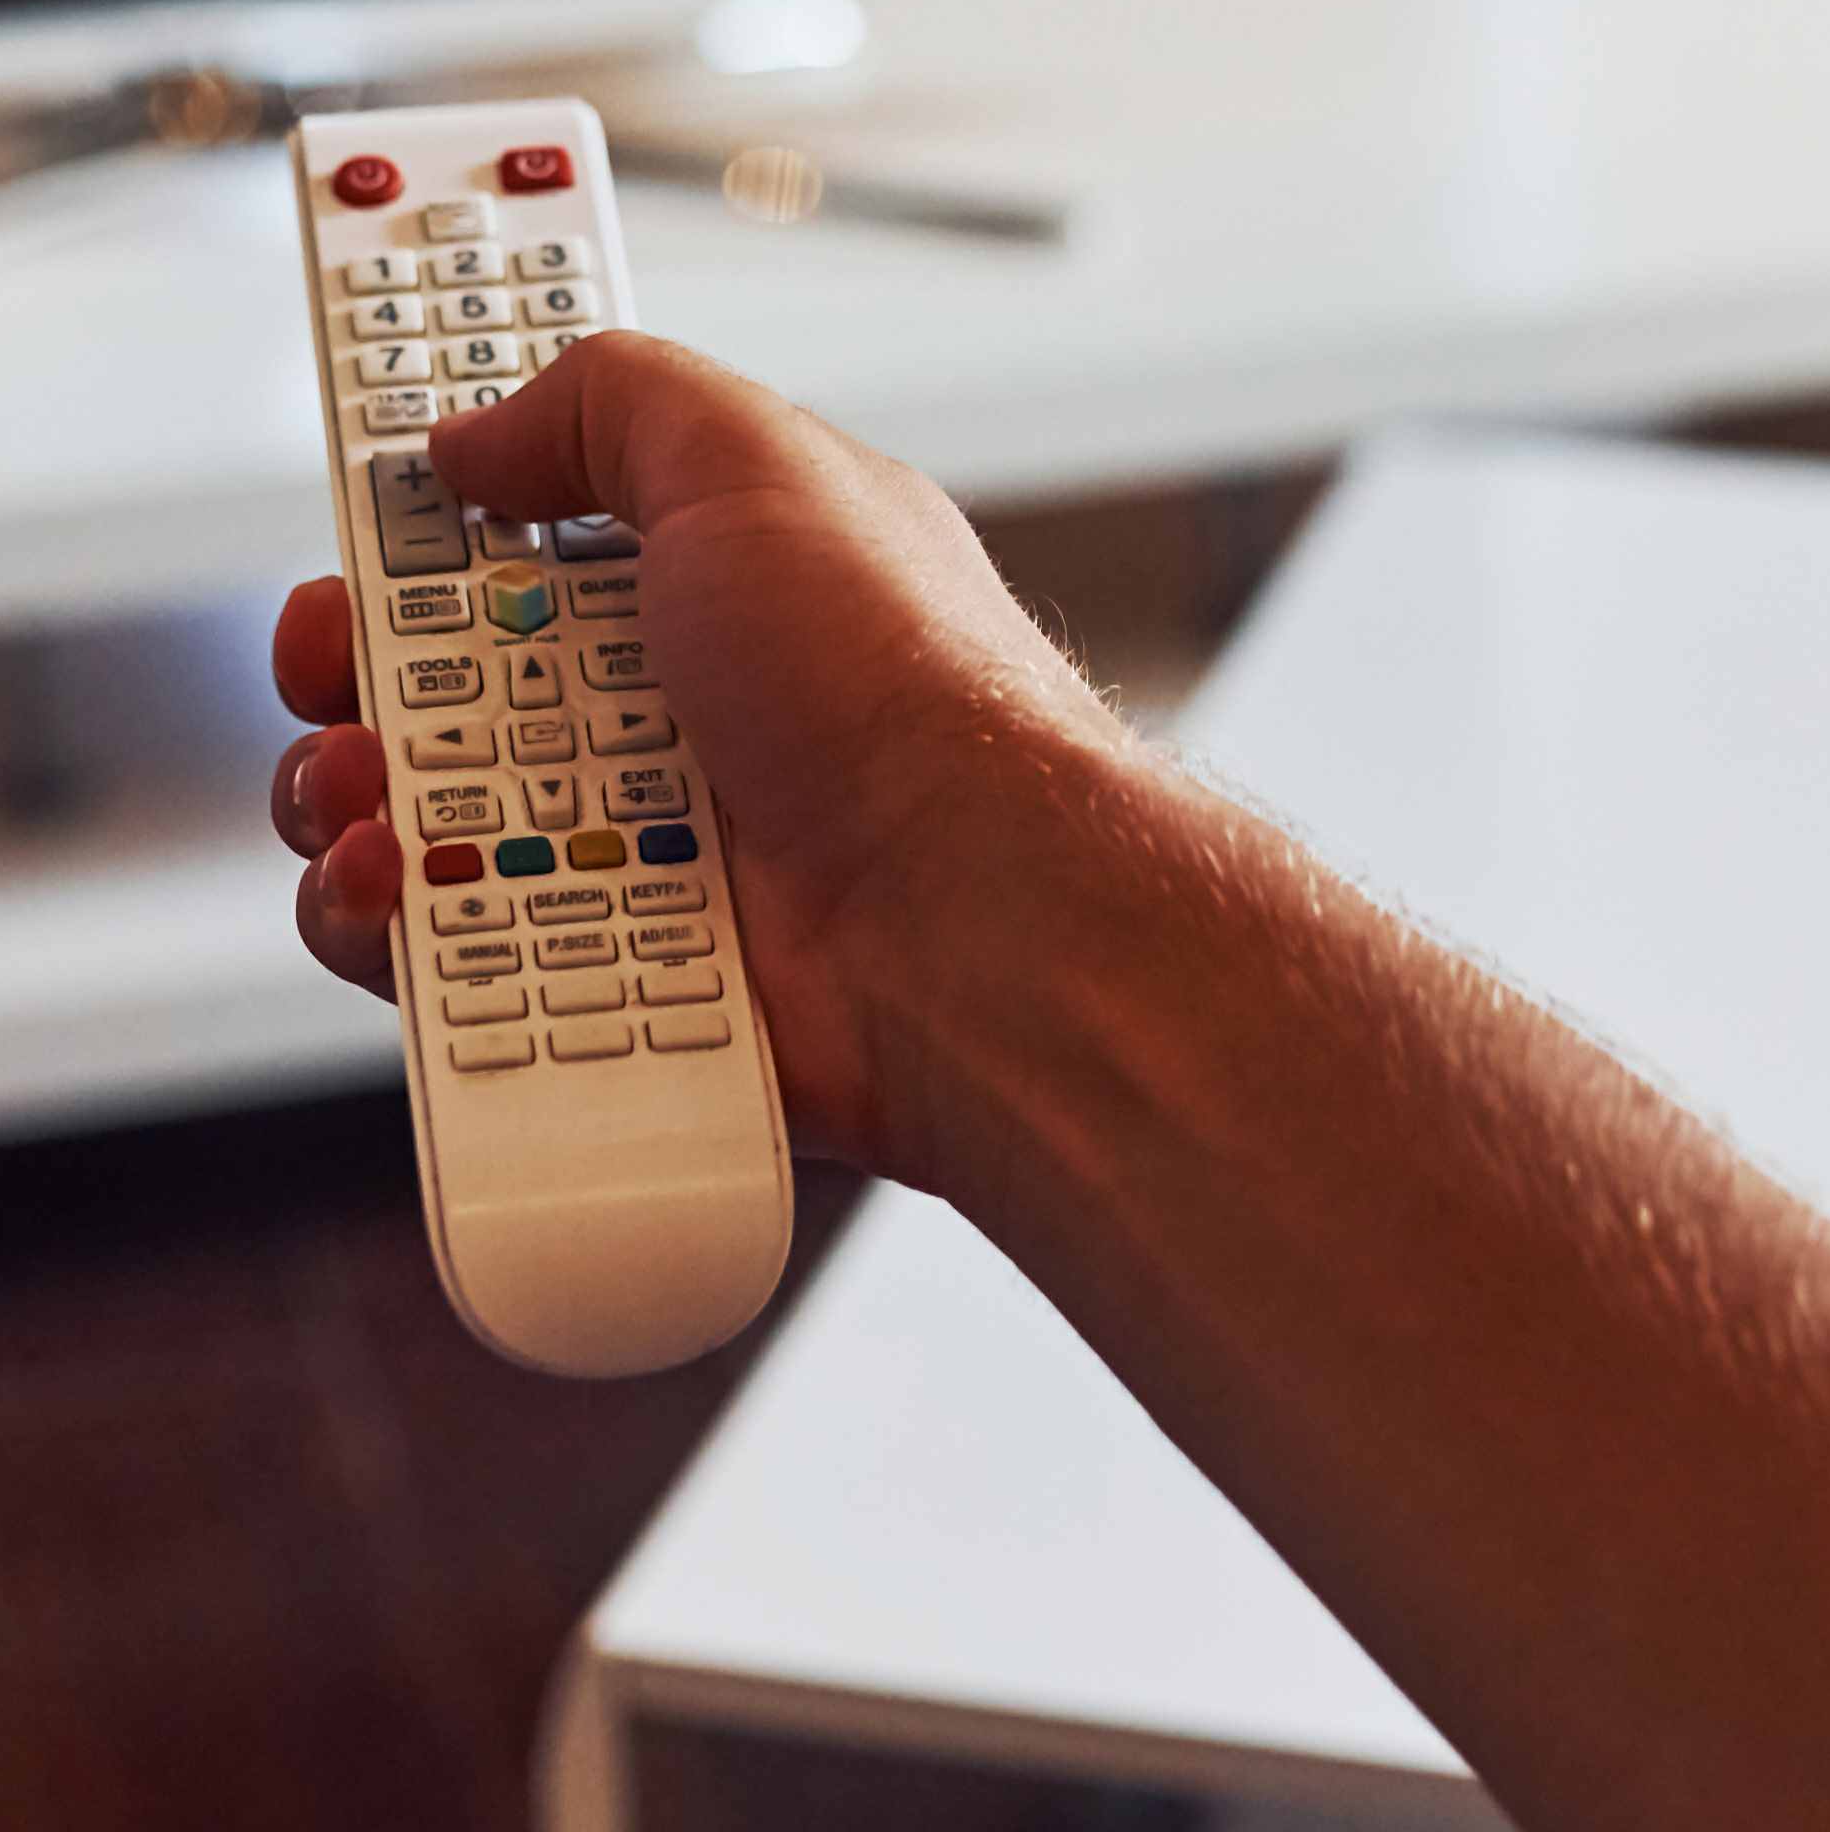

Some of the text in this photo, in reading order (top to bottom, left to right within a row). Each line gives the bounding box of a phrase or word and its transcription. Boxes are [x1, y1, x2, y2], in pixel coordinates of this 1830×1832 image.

[453, 250, 479, 275] 2
[540, 244, 567, 268] 3
[375, 257, 391, 279] 1
[461, 295, 488, 319] 5
[547, 288, 575, 312] 6
[373, 301, 399, 324] 4
[379, 346, 405, 372] 7
[468, 340, 496, 366] 8
[399, 583, 457, 601] MENU
[597, 641, 644, 657] INFO
[407, 655, 472, 675] TOOLS
[621, 768, 665, 785] EXIT
[427, 784, 488, 805] RETURN
[533, 888, 605, 910] SEARCH
[546, 932, 605, 953] P.SIZE
